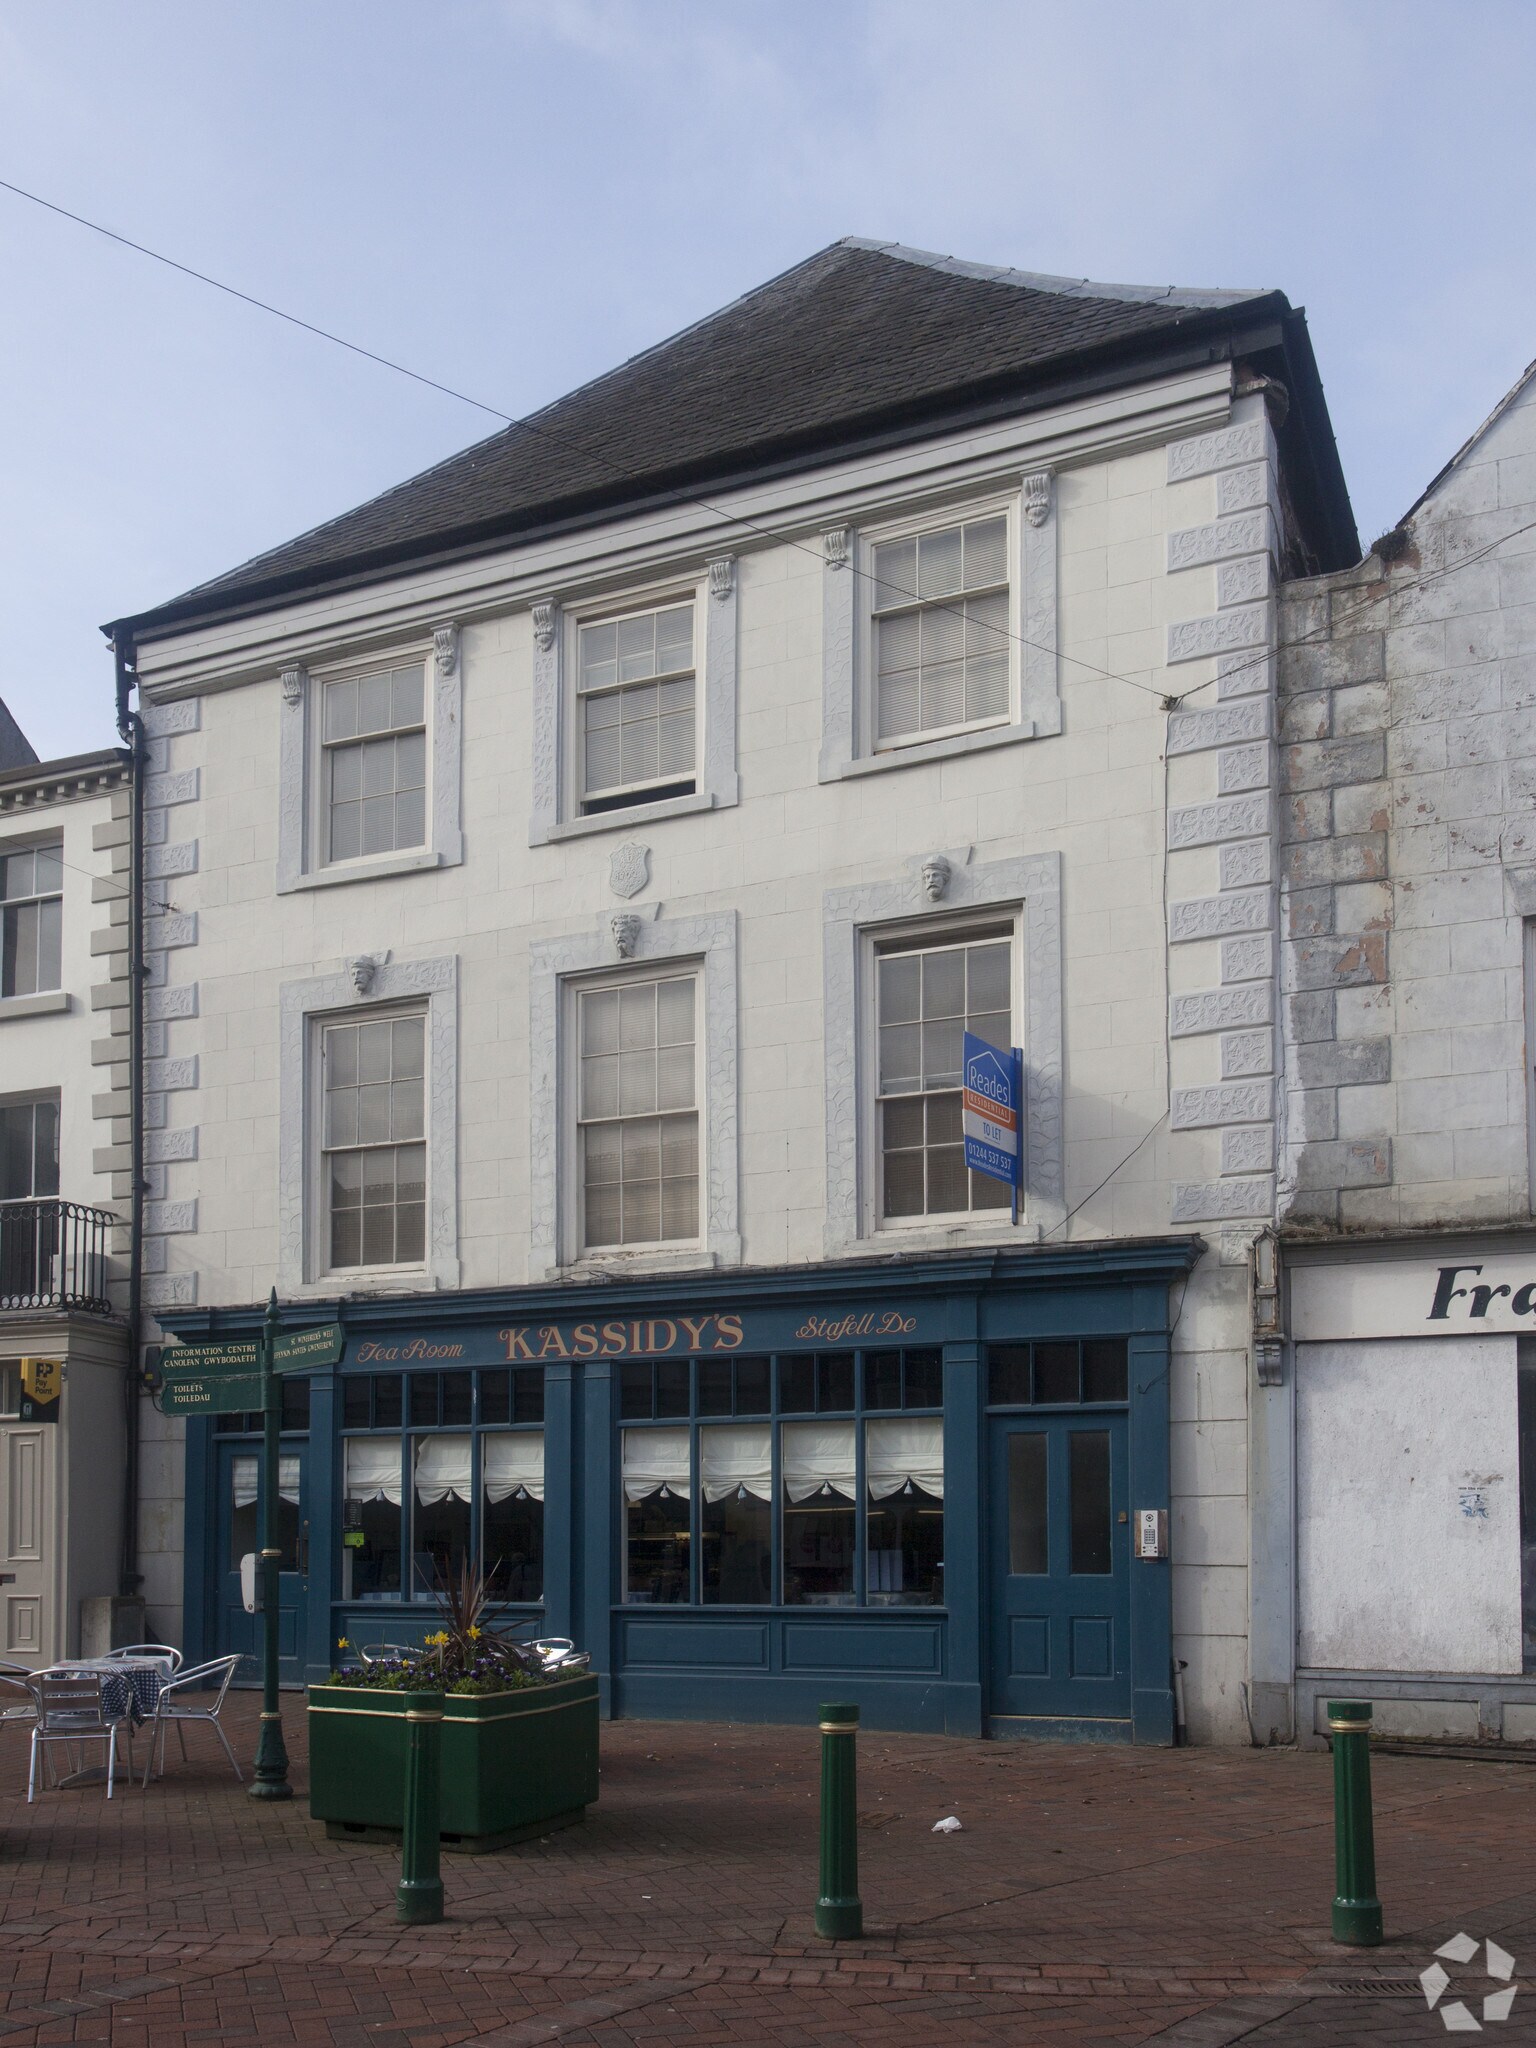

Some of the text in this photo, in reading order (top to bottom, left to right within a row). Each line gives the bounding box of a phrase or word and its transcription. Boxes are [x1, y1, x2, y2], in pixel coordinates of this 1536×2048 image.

[970, 1065, 1009, 1104] Reades
[969, 1094, 1009, 1119] RESIDENTIAL
[983, 1122, 1002, 1141] TO LET
[968, 1142, 1012, 1170] 01244 537 537
[795, 1311, 917, 1342] Stafell De
[498, 1313, 744, 1361] KASSIDY'S
[172, 1344, 256, 1358] INFORMATION CENTRE
[356, 1337, 466, 1363] Tea Room
[164, 1354, 256, 1368] CANOLFAN GWYBODAETH
[35, 1378, 47, 1388] Pay
[35, 1386, 52, 1394] Point
[173, 1384, 203, 1393] TOILETS
[173, 1394, 211, 1403] TOILEDAU
